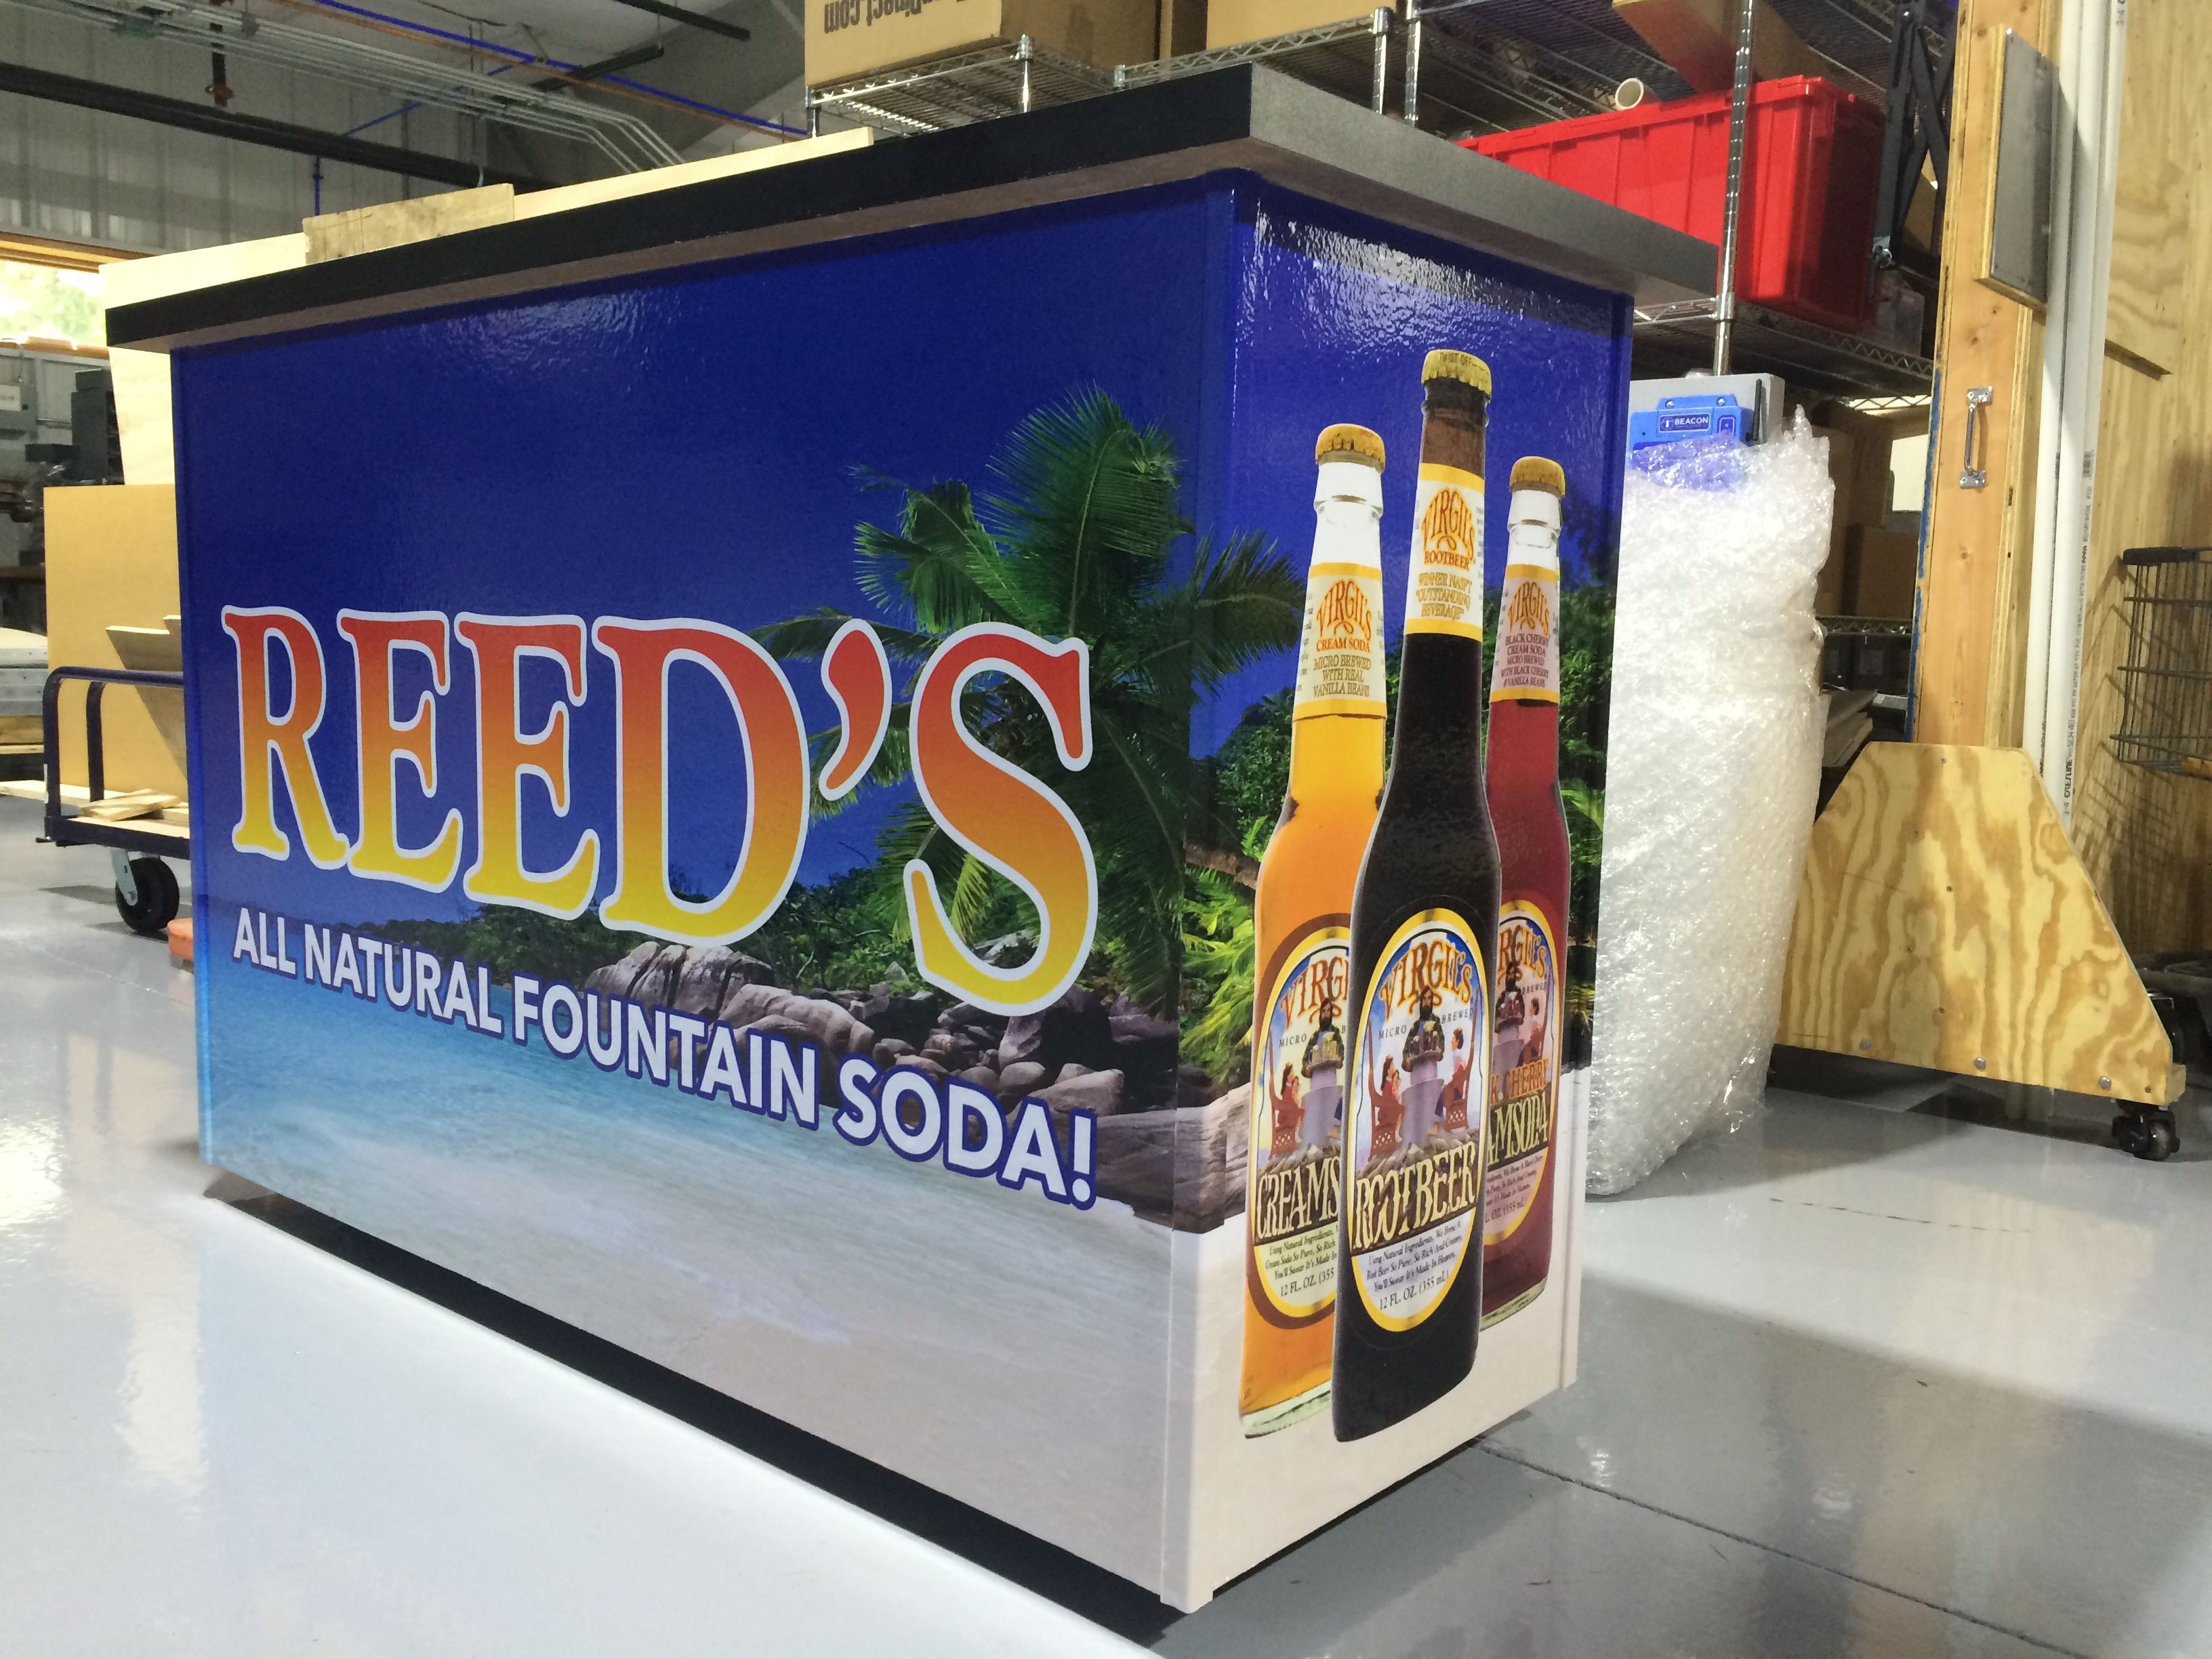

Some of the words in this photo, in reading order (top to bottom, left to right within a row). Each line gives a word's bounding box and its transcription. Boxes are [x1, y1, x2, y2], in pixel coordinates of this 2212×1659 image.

[1439, 352, 1459, 363] TWIST
[1674, 416, 1708, 426] BEACON
[1424, 551, 1469, 571] ROOTBEER
[1418, 572, 1448, 587] WINNER
[1316, 636, 1347, 652] CREAM
[1349, 637, 1371, 653] SODA
[1505, 634, 1525, 646] BLACK
[1526, 634, 1549, 647] CHERRY
[1507, 646, 1529, 656] CREAM
[1530, 646, 1546, 657] SODA
[1313, 655, 1339, 670] MICRO
[1340, 655, 1371, 670] BREWED
[1507, 655, 1523, 665] MICRO
[1523, 655, 1545, 666] BREWED
[1322, 668, 1345, 682] WITH
[1345, 669, 1364, 682] REAL
[1513, 666, 1530, 675] BLACK
[1313, 682, 1346, 697] VANILLA
[1347, 682, 1370, 697] BEANS
[221, 604, 1099, 1017] REED'S
[1379, 939, 1472, 1023] VIRGIL'S
[1378, 1025, 1407, 1040] MICRO
[1441, 1008, 1474, 1025] BREWED
[1278, 1033, 1307, 1048] MICRO
[232, 906, 297, 977] ALL
[304, 921, 506, 1040] NATURAL
[512, 972, 819, 1132] FOUNTAIN
[832, 1052, 1097, 1211] SODA!
[1502, 1059, 1549, 1101] CHERRY
[1353, 1141, 1476, 1250] ROOTBEER
[1283, 1237, 1303, 1252] Natural
[1293, 1252, 1300, 1261] So
[1315, 1244, 1323, 1253] So
[1383, 1244, 1404, 1262] Natural
[1315, 1255, 1330, 1266] Made
[1367, 1269, 1377, 1280] Root
[1378, 1266, 1389, 1277] Beer
[1391, 1263, 1397, 1272] So
[1414, 1253, 1420, 1263] So
[1421, 1246, 1433, 1260] Rich
[1389, 1274, 1404, 1286] Swear
[1415, 1262, 1430, 1275] Made
[1431, 1258, 1437, 1269] In
[1280, 1284, 1288, 1296] 12
[1290, 1281, 1301, 1294] FL.
[1303, 1274, 1316, 1288] OZ.
[1318, 1267, 1334, 1284] (355
[1380, 1297, 1387, 1310] 12
[1389, 1292, 1401, 1307] FL.
[1403, 1285, 1417, 1300] OZ.
[1419, 1275, 1435, 1295] (355
[1436, 1269, 1449, 1286] mL)
